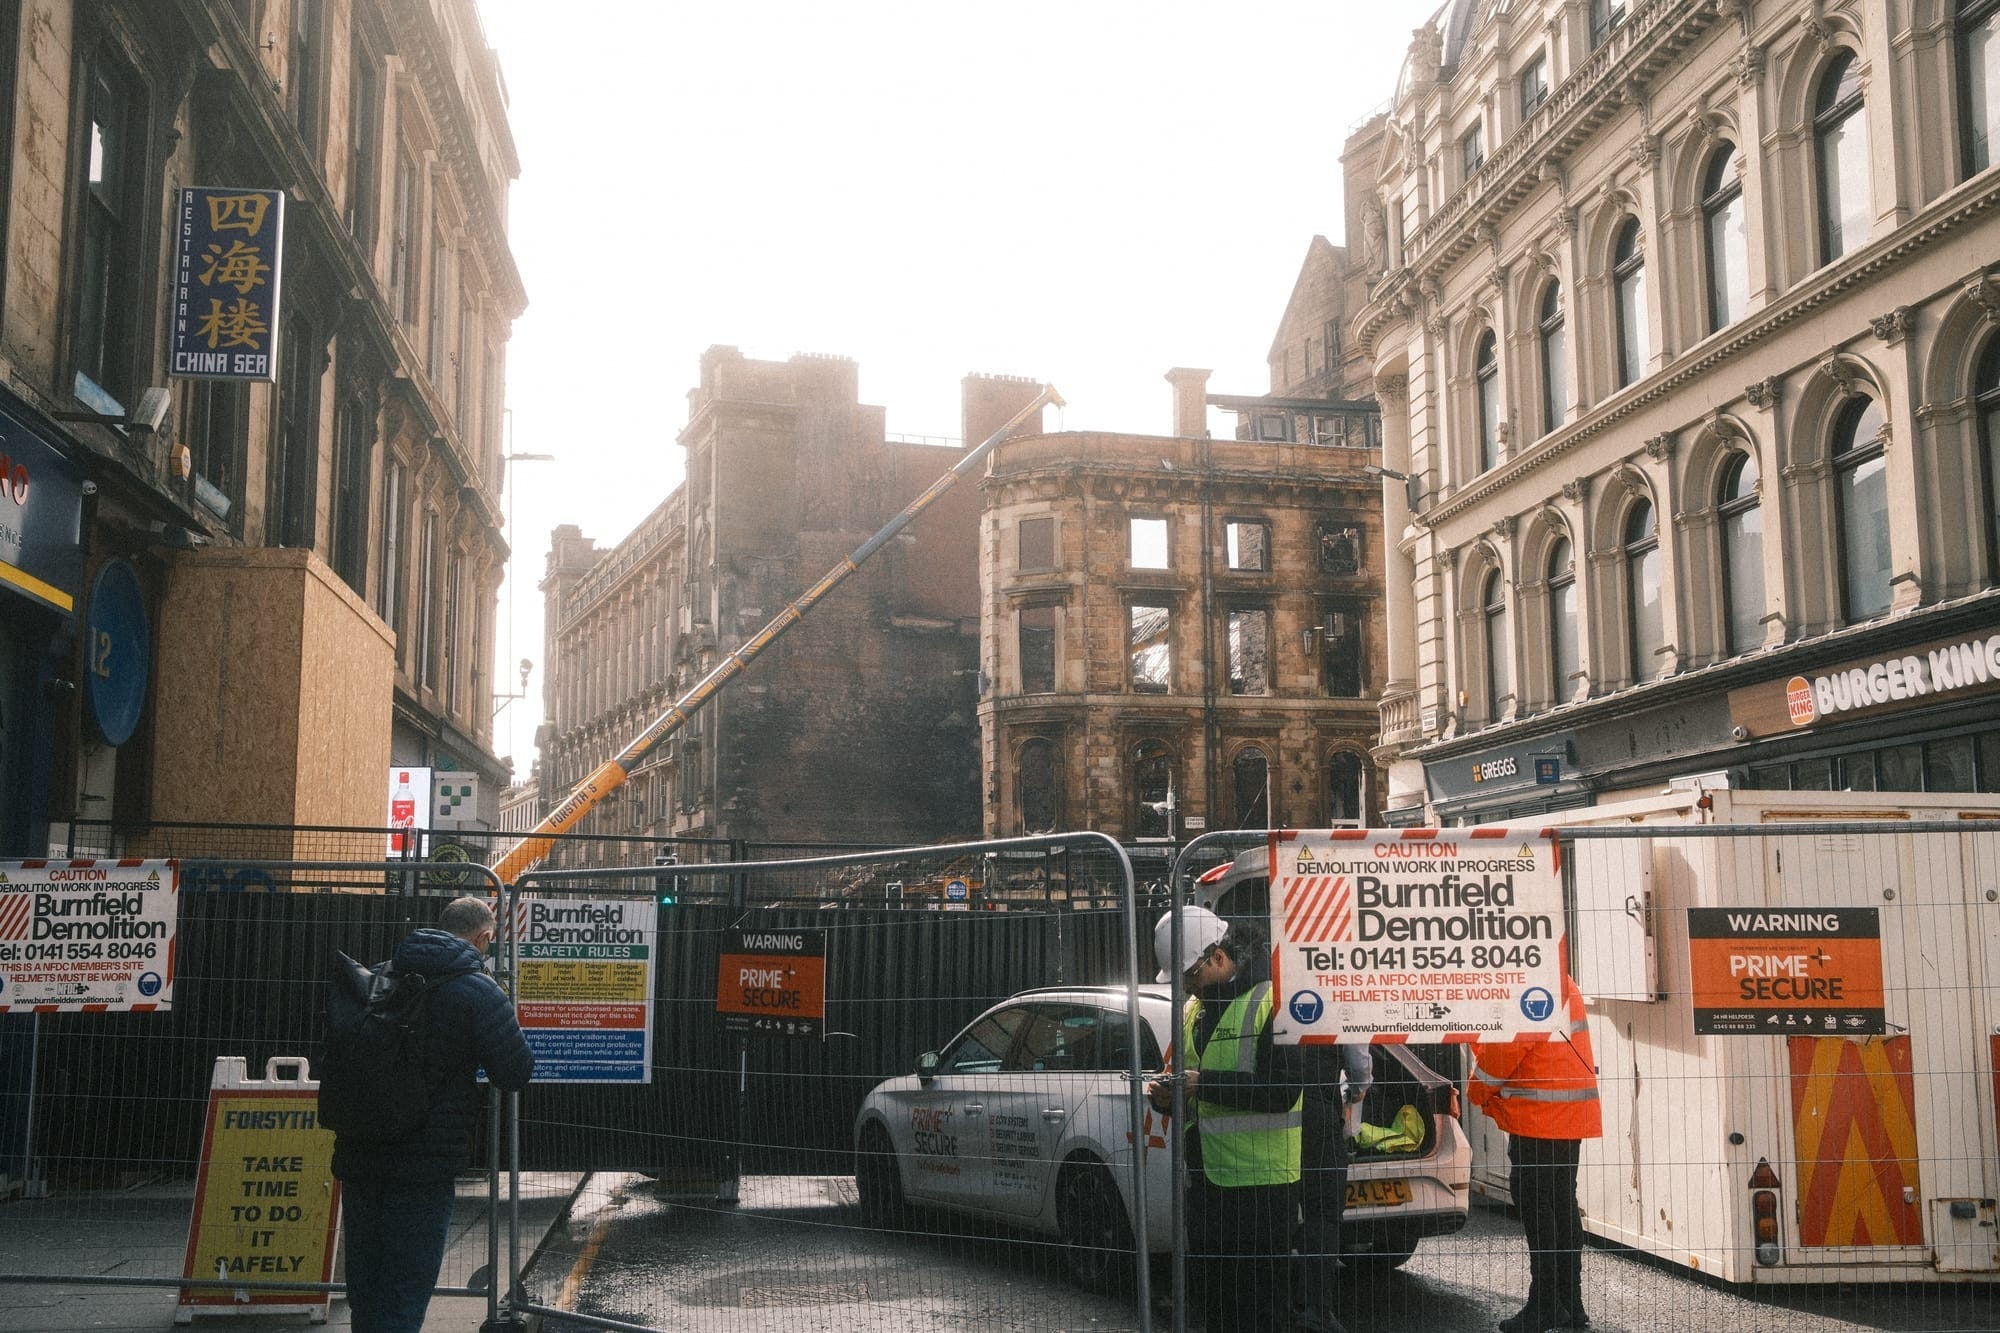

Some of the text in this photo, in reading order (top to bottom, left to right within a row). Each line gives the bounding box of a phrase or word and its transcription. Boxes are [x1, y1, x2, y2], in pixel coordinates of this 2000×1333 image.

[177, 191, 193, 348] RESTAURANT
[195, 193, 271, 350] 四海楼
[176, 352, 267, 374] CHINA SEA
[90, 626, 111, 678] 12
[1815, 635, 2000, 715] BURGER KING
[1788, 689, 1811, 702] BURGER
[1790, 699, 1813, 717] KING
[1481, 757, 1517, 780] GREGGS
[1374, 842, 1457, 858] CAUTION
[50, 869, 107, 881] CAUTION
[1297, 859, 1535, 874] DEMOLITION WORK IN PROGRESS
[0, 881, 160, 893] DEMOLITION WORK IN PROGRESS
[1357, 874, 1514, 908] Burnfield
[34, 892, 143, 917] Burnfield
[531, 903, 623, 924] Burnfield
[32, 916, 166, 941] Demolition
[1358, 908, 1552, 942] Demolition
[1727, 914, 1840, 932] WARNING
[530, 923, 643, 944] Demolition
[742, 934, 803, 950] WARNING
[25, 943, 63, 960] 0141
[67, 943, 103, 960] 554
[108, 942, 157, 959] 8046
[532, 945, 583, 957] SAFETY
[588, 945, 631, 958] RULES
[1299, 944, 1542, 971] Tel: 0141 554 8046
[1, 961, 144, 972] THIS IS A NFDC MEMBER'S SITE
[521, 962, 544, 971] Danger
[553, 962, 577, 971] Danger
[585, 963, 608, 972] Danger
[616, 963, 639, 972] Danger
[1729, 955, 1808, 977] PRIME
[10, 972, 132, 983] HELMETS MUST BE WORN
[739, 968, 782, 989] PRIME
[1315, 972, 1526, 987] THIS IS A NFDC MEMBER'S SITE
[1332, 988, 1510, 1002] HELMETS MUST BE WORN
[1739, 977, 1844, 1000] SECURE
[742, 988, 801, 1009] SECURE
[571, 1019, 602, 1027] smoking.
[1342, 1021, 1503, 1033] www.burnfielddemolition.co.uk
[527, 1033, 626, 1042] employees and visitors must
[548, 1041, 574, 1049] correct
[575, 1041, 606, 1050] personal
[607, 1042, 642, 1050] protective
[224, 1110, 316, 1130] FORSYTH
[914, 1131, 958, 1159] SECURE
[242, 1156, 303, 1172] TAKE
[242, 1181, 299, 1197] TIME
[1345, 1180, 1405, 1203] 24 LPC
[231, 1205, 302, 1222] TO DO
[251, 1231, 275, 1247] IT
[214, 1255, 305, 1273] SAFELY
